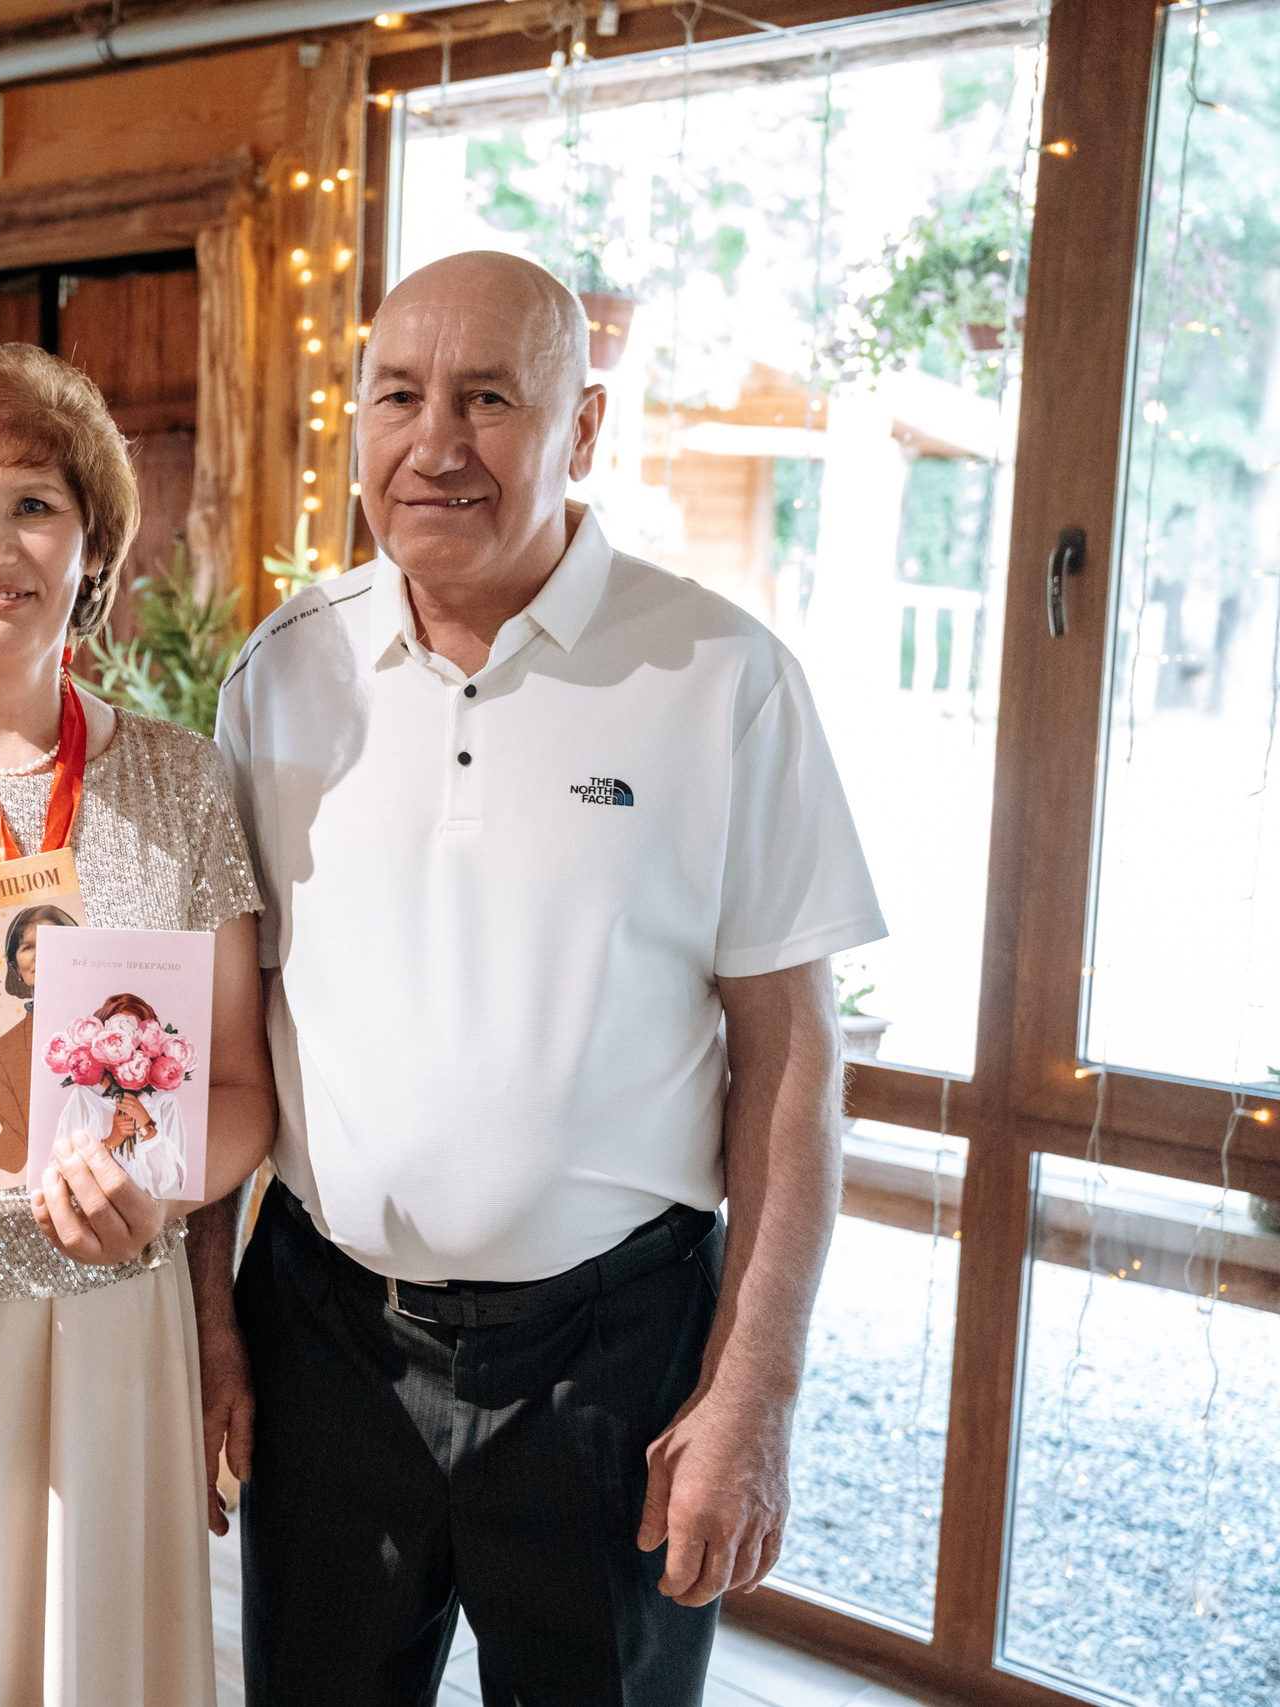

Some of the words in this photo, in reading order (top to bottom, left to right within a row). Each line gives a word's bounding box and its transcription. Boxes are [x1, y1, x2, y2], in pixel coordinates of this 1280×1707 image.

[270, 615, 298, 635] SPORT
[300, 607, 319, 619] RUN
[589, 777, 613, 787] THE
[570, 785, 613, 795] NORTH
[581, 795, 612, 805] FACE
[72, 959, 88, 967] Всё
[91, 960, 123, 969] просто
[126, 961, 182, 972] ПРЕКРАСНО
